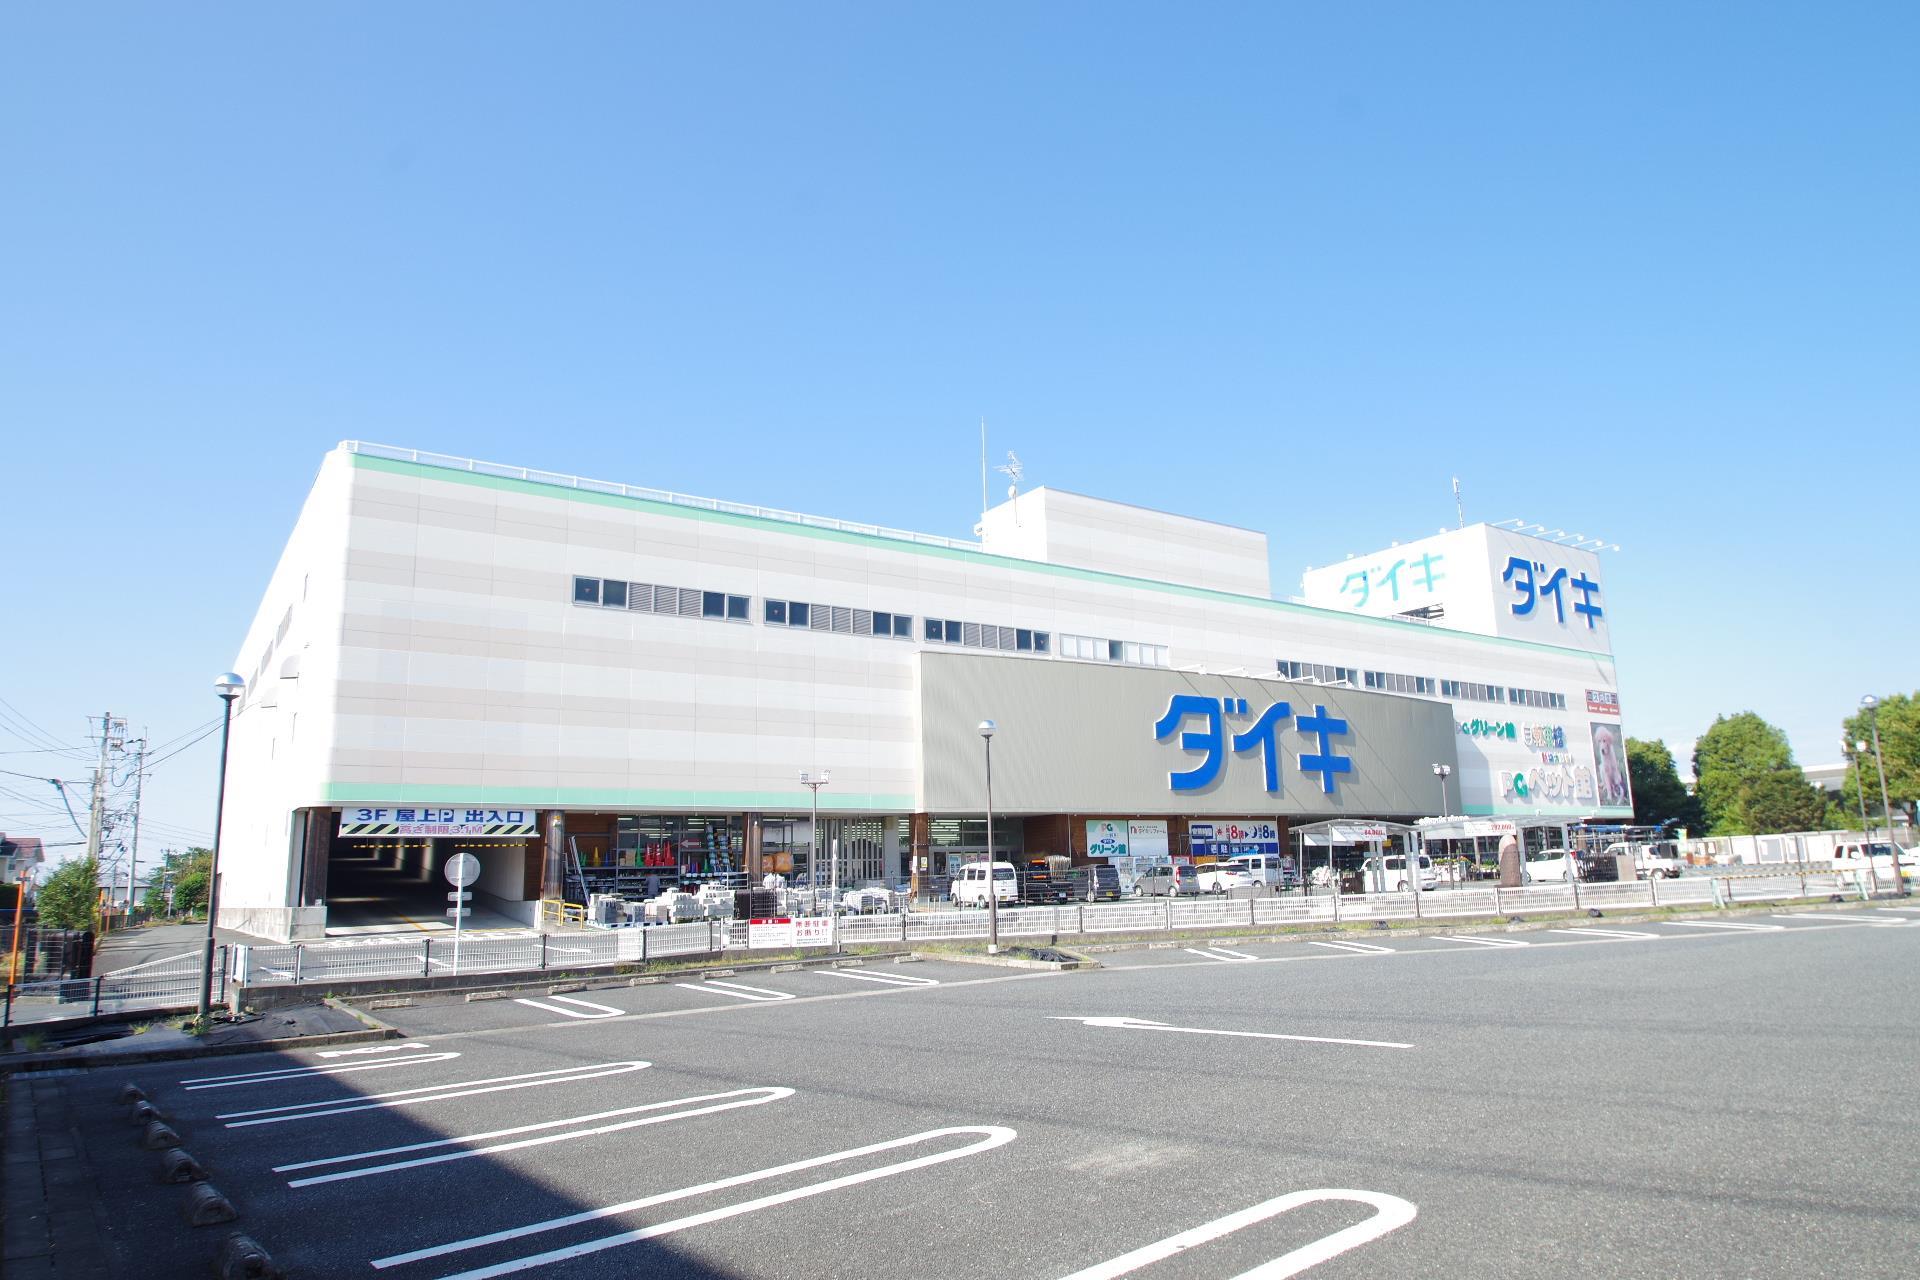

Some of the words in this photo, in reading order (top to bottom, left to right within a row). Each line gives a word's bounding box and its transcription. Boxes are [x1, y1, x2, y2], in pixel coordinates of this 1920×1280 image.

[1340, 552, 1446, 607] ダイキ
[1503, 556, 1603, 629] ダイキ
[1154, 694, 1352, 793] ダイキ
[356, 808, 388, 821] 3F
[465, 810, 524, 823] 出入口
